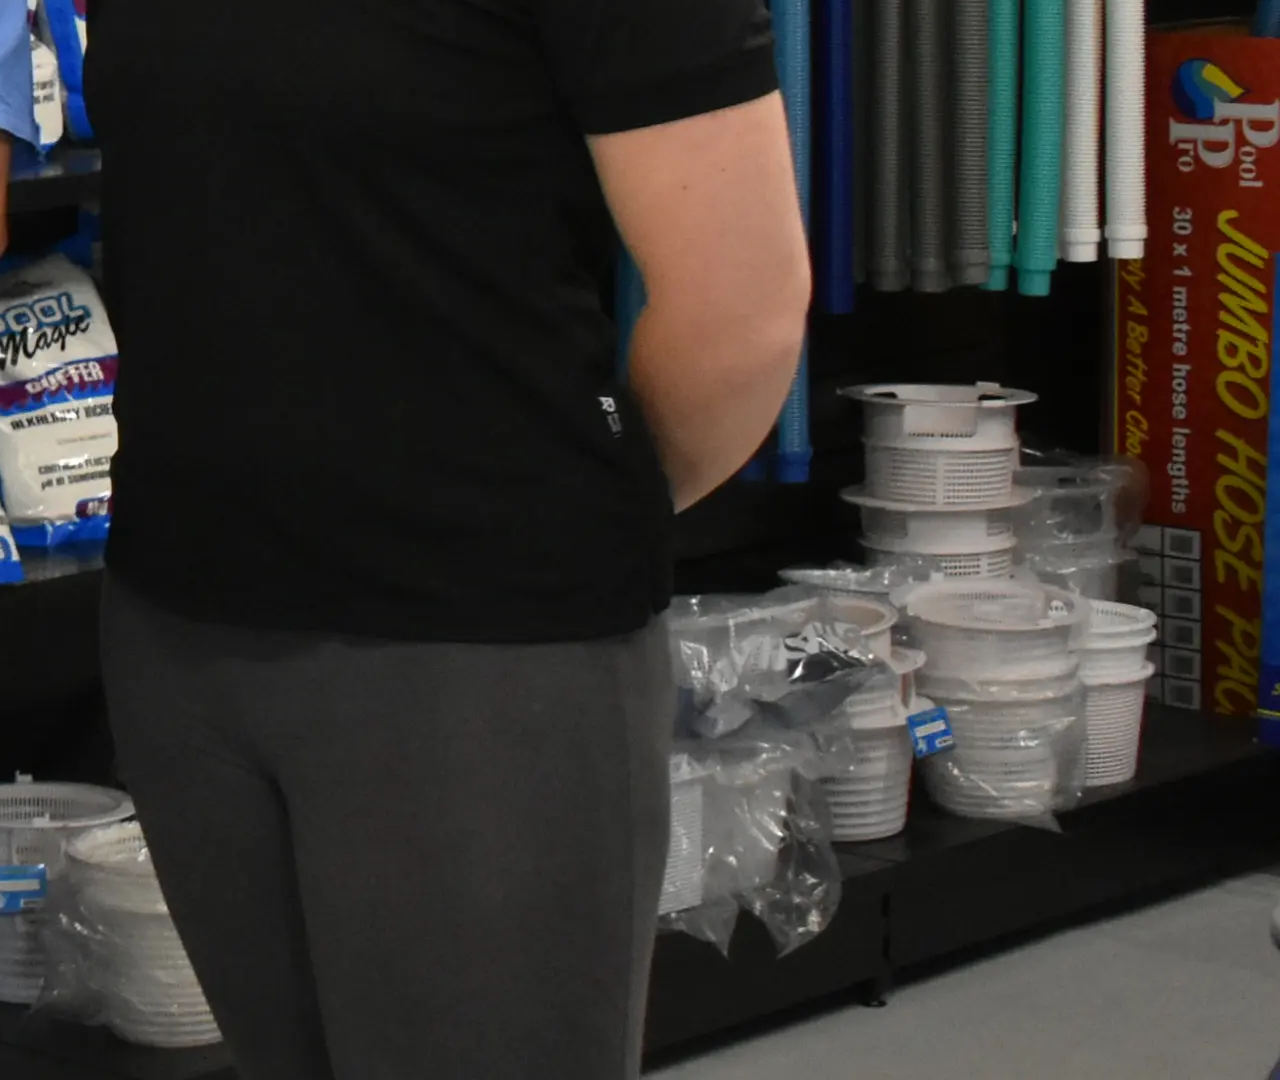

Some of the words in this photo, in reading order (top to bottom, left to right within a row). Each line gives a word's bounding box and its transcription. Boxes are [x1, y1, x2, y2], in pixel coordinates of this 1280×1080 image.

[1168, 116, 1236, 172] Pro
[1213, 97, 1280, 188] Pool
[1172, 206, 1193, 236] 30
[1172, 242, 1187, 257] x
[1173, 267, 1193, 277] 1
[1126, 295, 1148, 317] A
[1171, 286, 1193, 356] metre
[1215, 209, 1269, 420] JUMBO
[25, 362, 105, 394] BUFFER
[1124, 324, 1149, 406] Better
[1171, 363, 1192, 420] hose
[1167, 427, 1191, 514] lengths
[1212, 428, 1267, 592] HOSE
[1213, 604, 1260, 717] PAC
